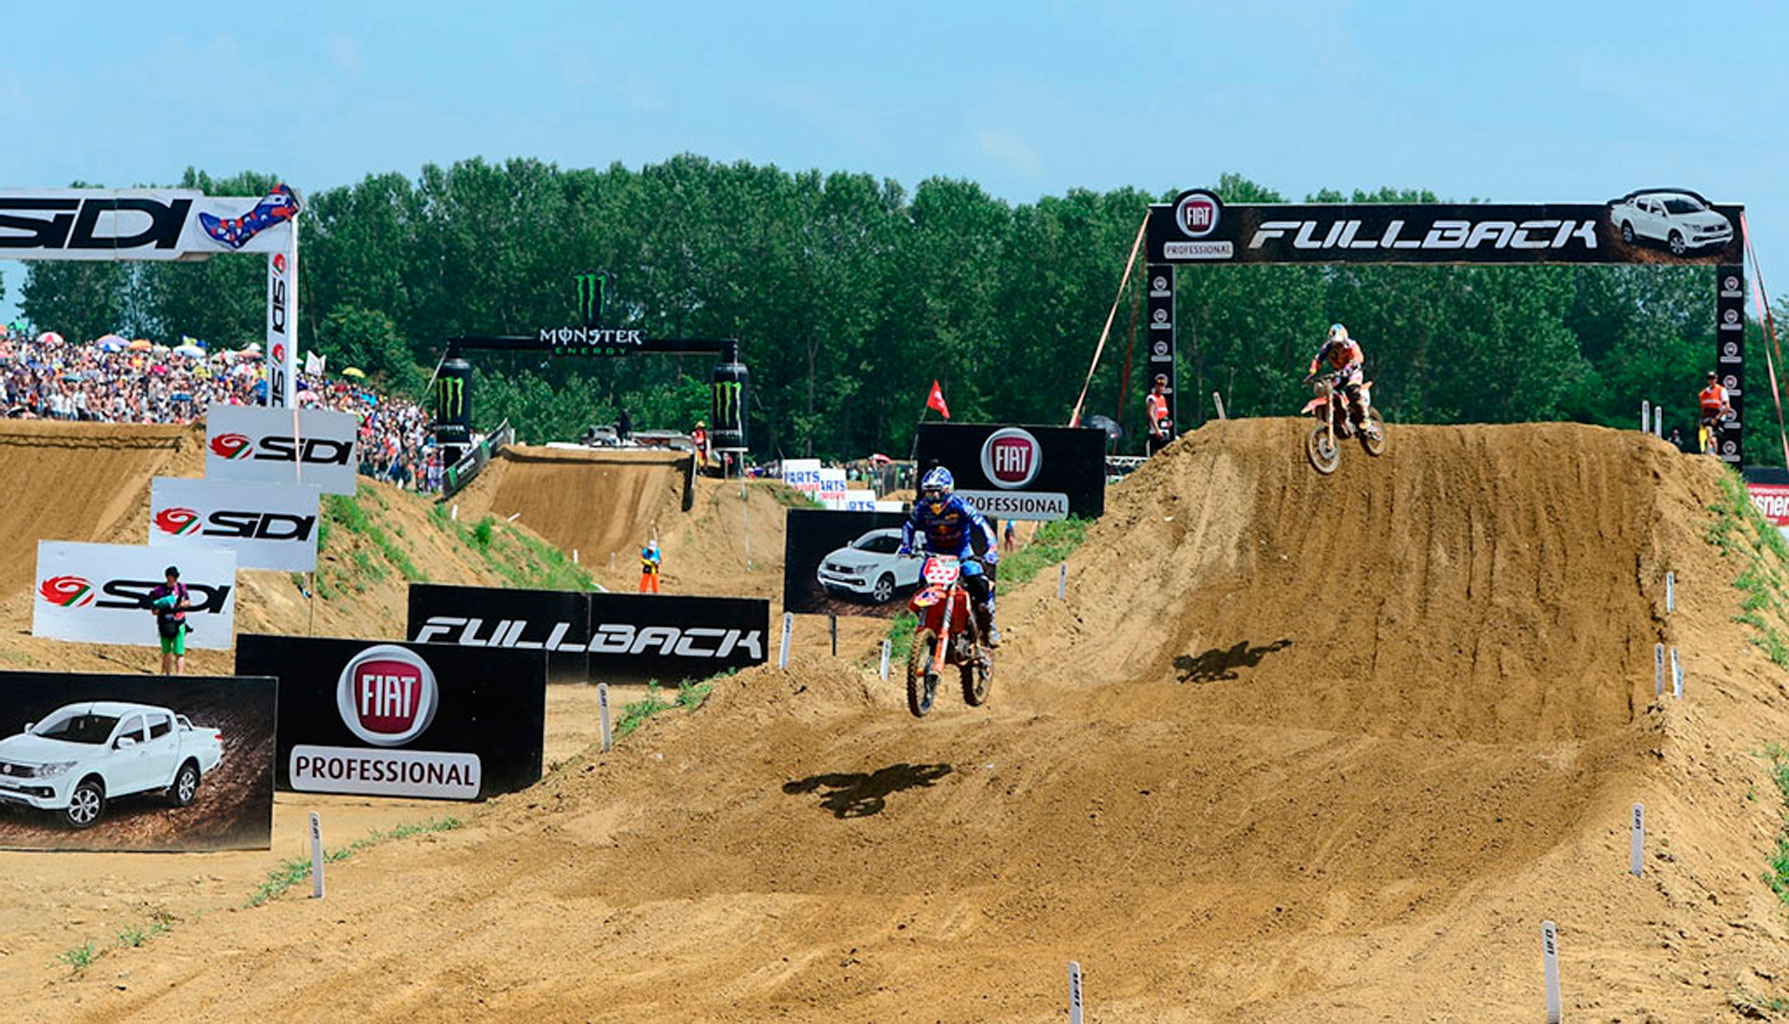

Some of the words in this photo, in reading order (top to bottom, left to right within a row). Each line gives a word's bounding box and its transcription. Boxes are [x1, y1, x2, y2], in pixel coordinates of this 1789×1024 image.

[1186, 207, 1211, 226] FIAT
[1248, 220, 1598, 249] FULLBACK
[1166, 244, 1231, 256] PROFESSIONAL
[539, 326, 642, 345] MONSTER
[995, 445, 1029, 473] FIAT
[966, 496, 1065, 513] ROFESSIONAL
[203, 511, 316, 541] SIDI
[415, 617, 763, 660] FULLBACK
[362, 674, 416, 719] FIAT
[296, 755, 476, 786] PROFESSIONAL
